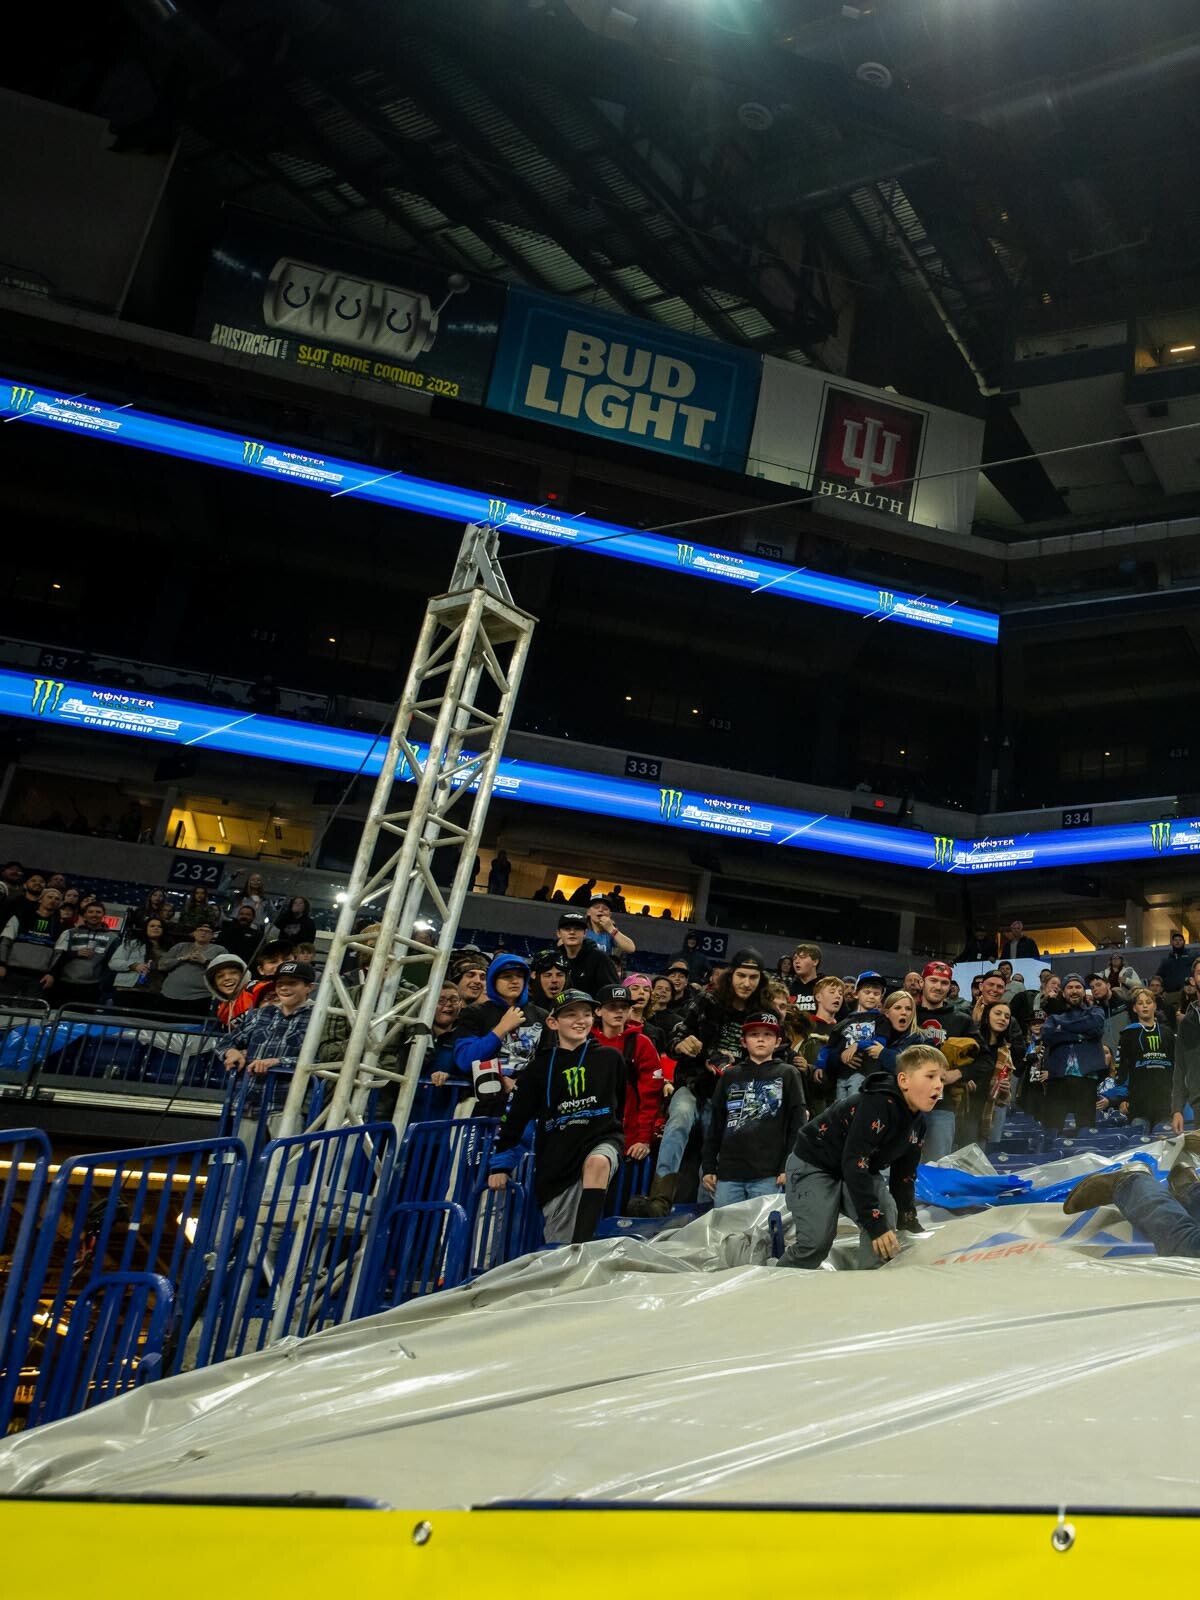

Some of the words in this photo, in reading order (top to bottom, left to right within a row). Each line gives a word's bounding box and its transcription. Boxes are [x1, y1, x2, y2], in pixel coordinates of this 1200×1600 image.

[298, 345, 329, 363] SLOT
[332, 352, 370, 374] GAME
[373, 362, 424, 388] COMING
[426, 377, 460, 397] 2023
[561, 330, 695, 398] BUD
[55, 398, 101, 413] MONSTER
[524, 365, 716, 449] LIGHT
[49, 415, 100, 430] CHAMPIONSHIP
[283, 452, 324, 466] MONSTER
[818, 480, 904, 515] HEALTH
[524, 509, 560, 521] MONSTER
[92, 691, 155, 709] MONSTER
[60, 703, 181, 729] SUPERCROSS
[84, 716, 153, 733] CHAMPIONSHIP
[628, 760, 658, 776] 333
[704, 799, 751, 813] MONSTER
[1065, 813, 1089, 824] 334
[701, 821, 752, 834] CHAMPIONSHIP
[973, 840, 1014, 848] MONSTER
[174, 862, 218, 882] 232
[972, 861, 1017, 869] CHAMPIONSHIP
